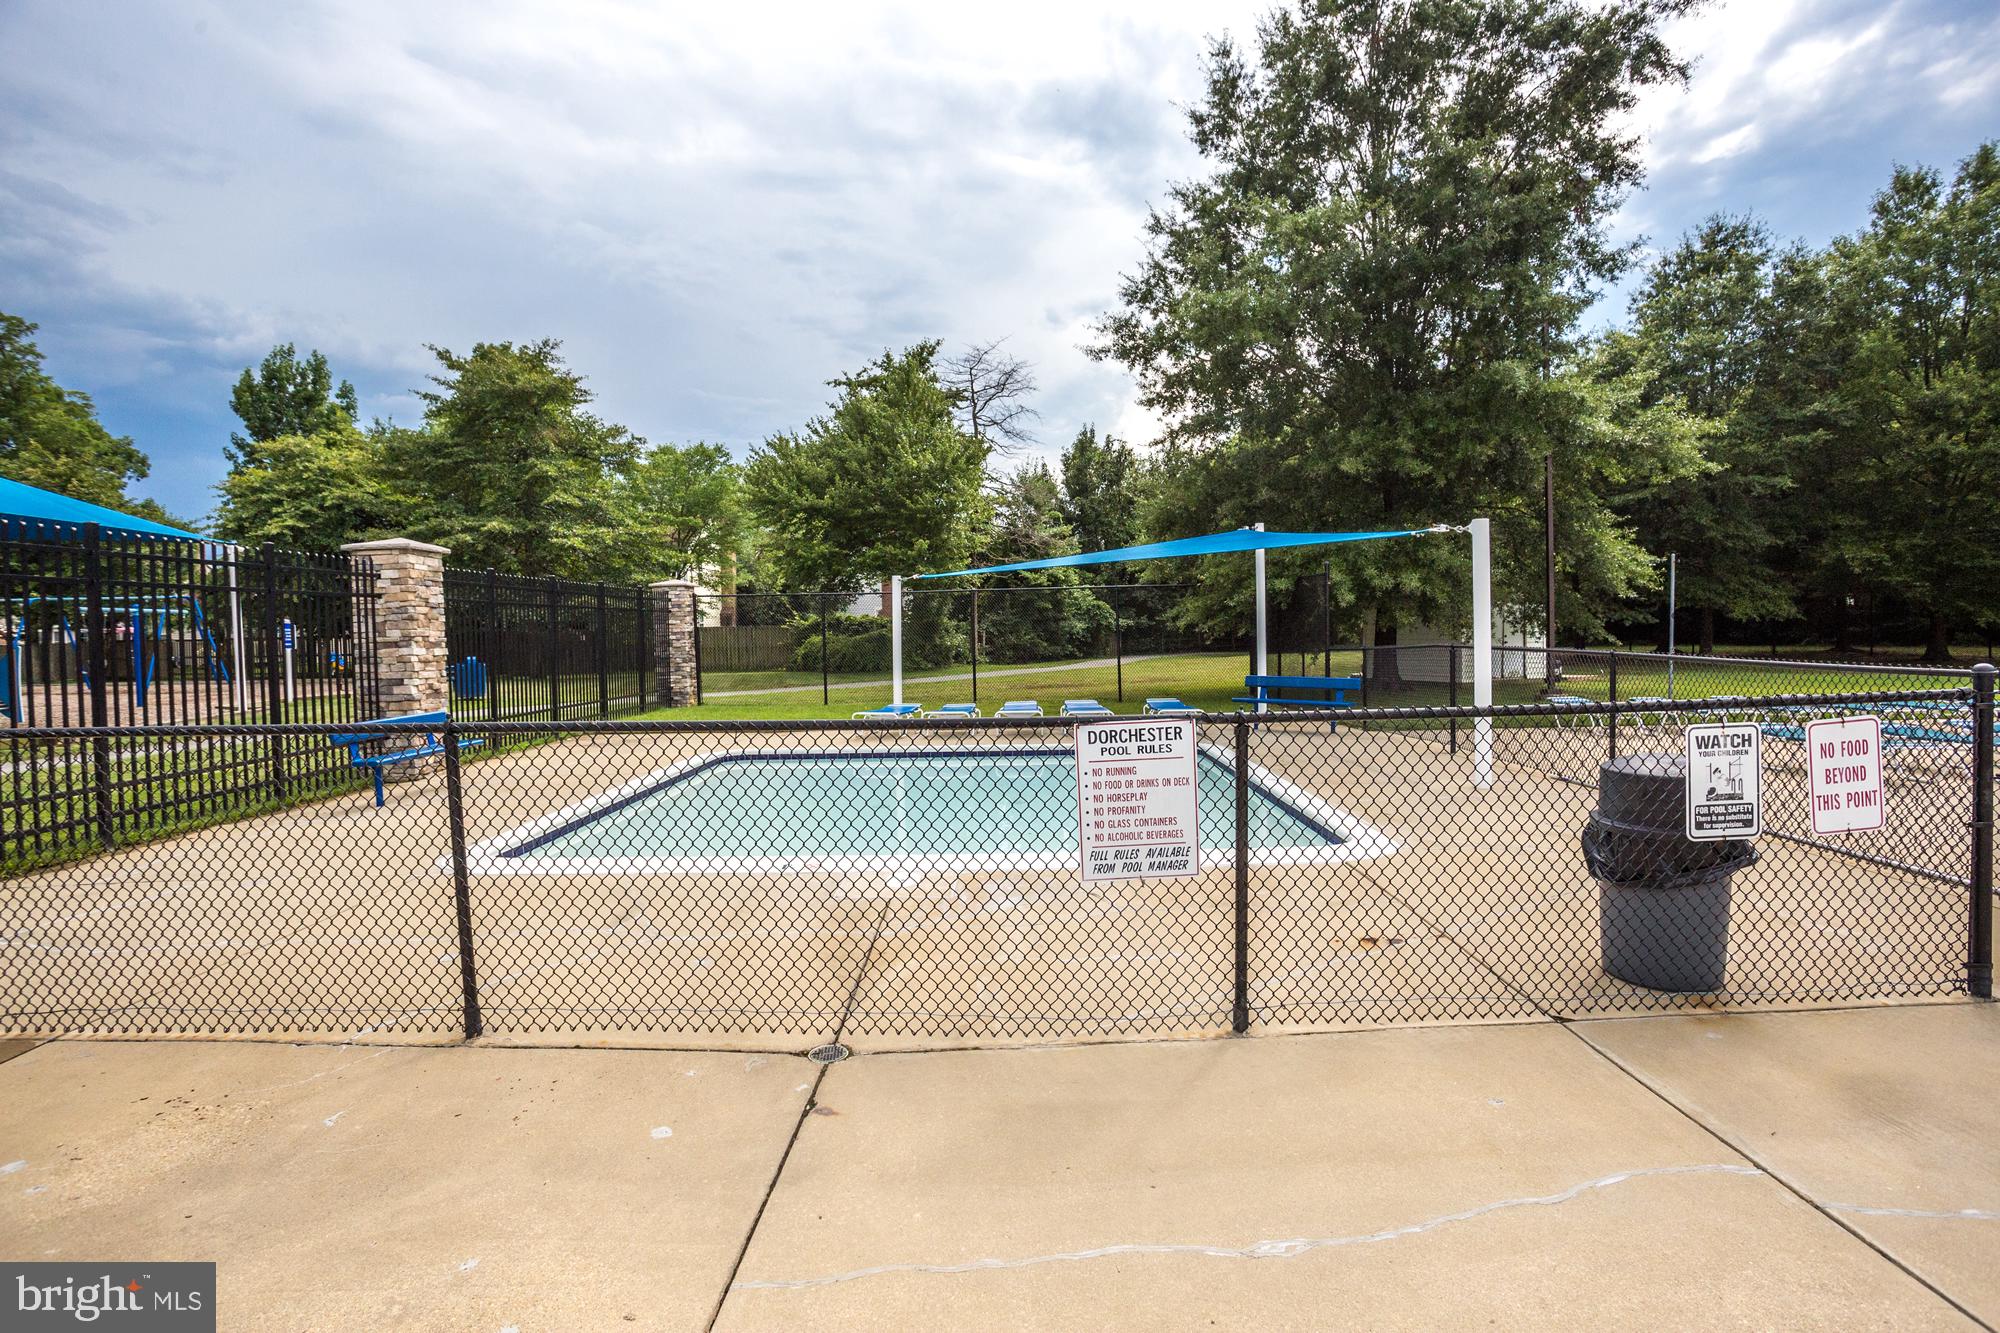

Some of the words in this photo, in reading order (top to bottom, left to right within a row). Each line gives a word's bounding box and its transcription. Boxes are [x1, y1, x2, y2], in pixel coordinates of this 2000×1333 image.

[1088, 726, 1183, 745] DORCHESTER
[1695, 734, 1752, 750] WATCH
[1101, 746, 1131, 756] POOL
[1137, 744, 1173, 754] RULES
[1820, 742, 1834, 759] NO
[1841, 739, 1869, 757] FOOD
[1092, 768, 1102, 777] NO
[1106, 766, 1137, 776] RUNNING
[1825, 765, 1867, 784] BEYOND
[1092, 781, 1102, 790] NO
[1104, 780, 1122, 790] FOOD
[1125, 780, 1134, 788] OR
[1136, 778, 1160, 788] DRINKS
[1162, 778, 1171, 786] ON
[1174, 777, 1190, 786] DECK
[1094, 794, 1104, 803] NO
[1107, 792, 1148, 802] HORSEPLAY
[1816, 794, 1840, 811] THIS
[1847, 790, 1878, 808] POINT
[1094, 808, 1104, 816] NO
[1108, 806, 1146, 816] PROFANITY
[1710, 806, 1726, 814] POOL
[1728, 804, 1752, 812] SAFETY
[1094, 820, 1104, 829] NO
[1108, 820, 1130, 828] GLASS
[1134, 817, 1178, 828] CONTAINERS
[1095, 834, 1104, 842] NO
[1108, 831, 1144, 842] ALCOHOLIC
[1146, 830, 1184, 840] BEVERAGES
[1090, 850, 1108, 861] FULL
[1114, 848, 1140, 860] RULES
[1145, 846, 1191, 859] AVAILABLE
[1092, 863, 1116, 874] FROM
[1122, 862, 1142, 872] POOL
[1148, 860, 1189, 872] MANAGER
